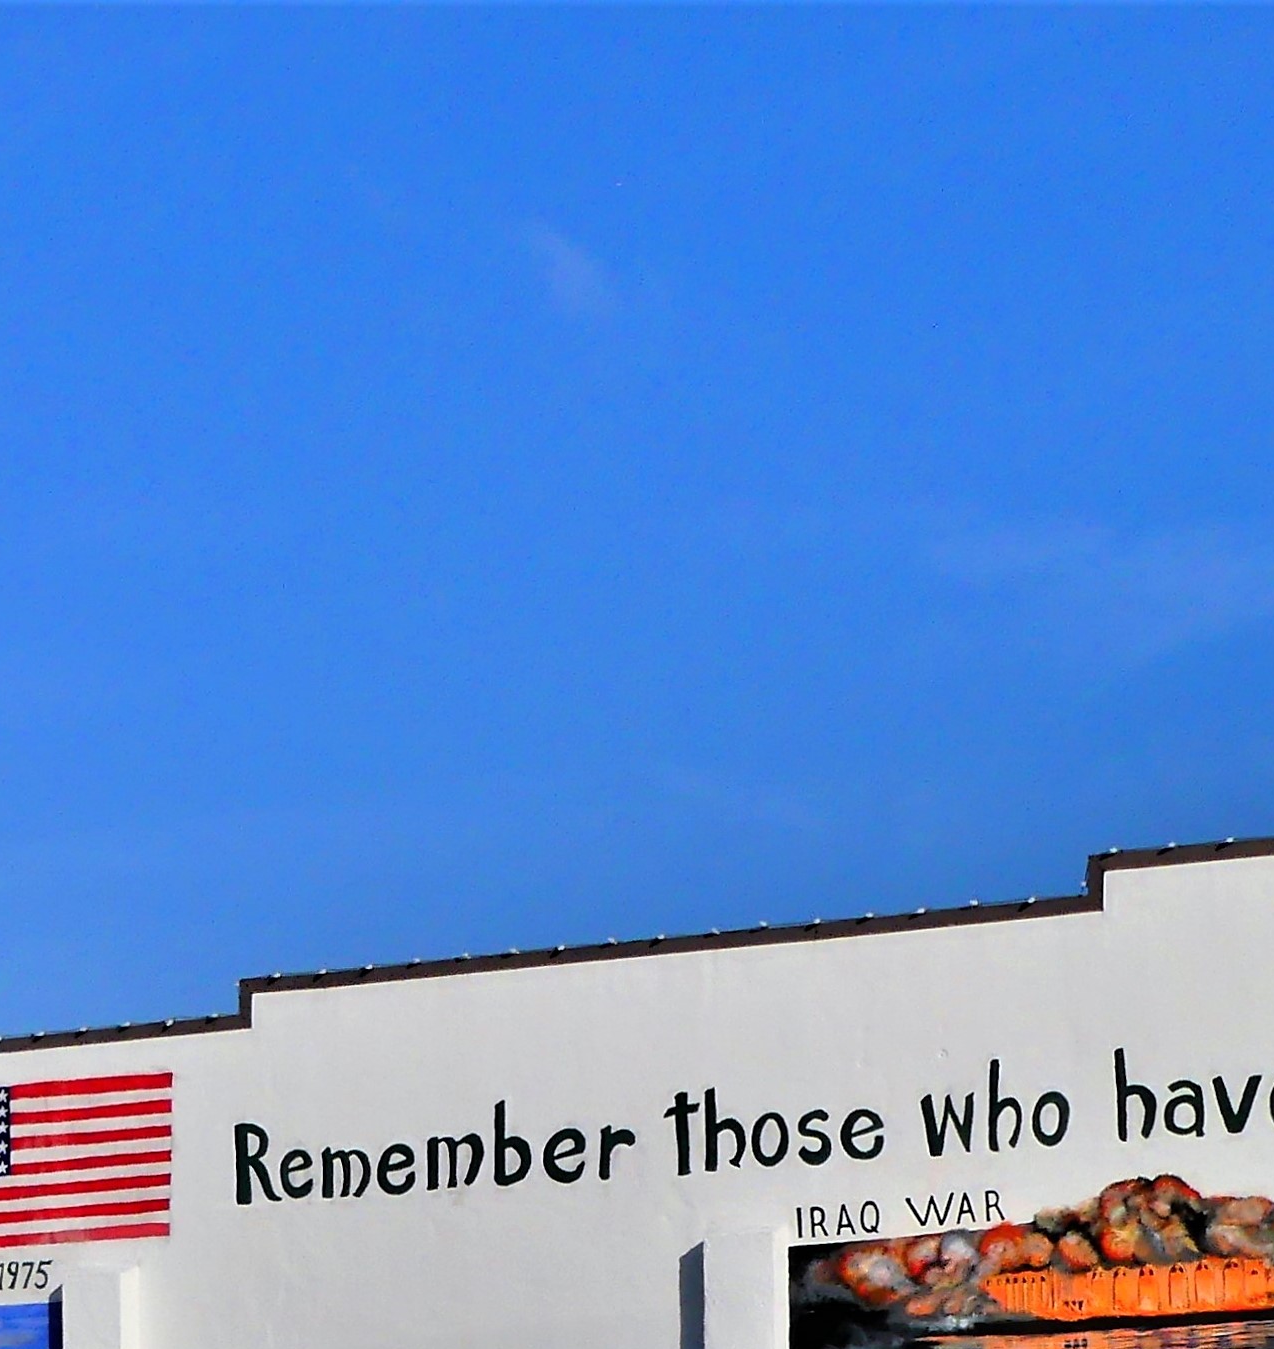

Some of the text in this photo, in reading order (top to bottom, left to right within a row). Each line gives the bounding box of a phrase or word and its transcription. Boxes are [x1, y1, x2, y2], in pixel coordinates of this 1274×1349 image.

[233, 1099, 636, 1206] Remember
[663, 1086, 886, 1178] those
[919, 1058, 1071, 1158] who
[795, 1200, 882, 1239] IRAQ
[905, 1190, 1006, 1228] WAR
